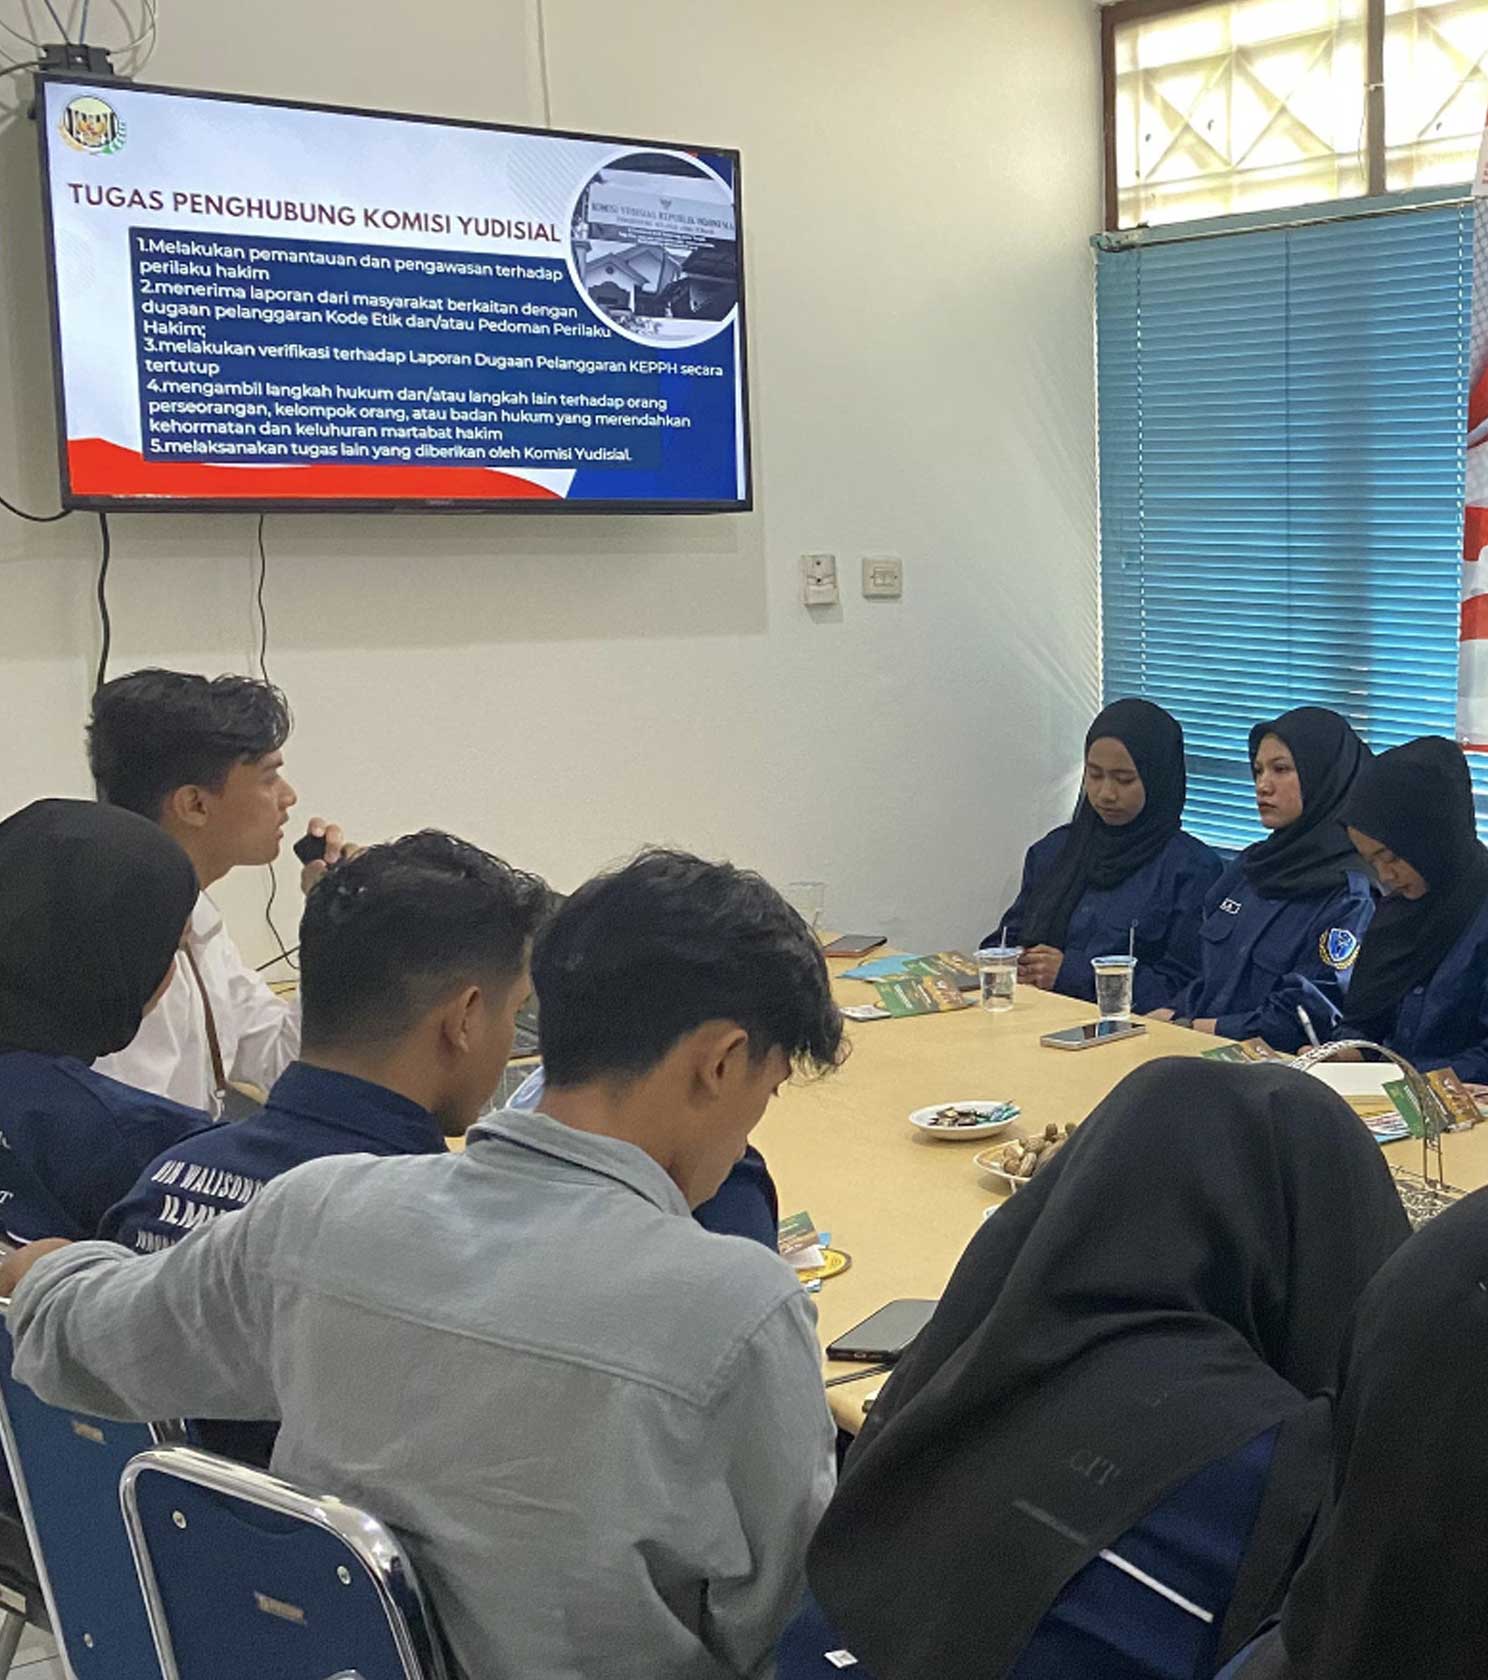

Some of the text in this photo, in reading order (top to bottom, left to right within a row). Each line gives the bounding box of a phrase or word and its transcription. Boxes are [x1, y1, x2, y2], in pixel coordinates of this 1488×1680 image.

[68, 183, 561, 242] TUGAS PENGHUBUNG KOMISI YUDISIAL
[136, 237, 563, 282] 1.Melakukan pemantauan dan pengawasan terhadap
[140, 260, 269, 280] perilaku hakim
[140, 279, 577, 320] 2.menerima laporan dari masyarakat berkaitan dengan
[142, 300, 611, 338] dugaan pelanggaran Kode Etik dan/atau Pedoman Perilaku
[144, 320, 206, 338] Hakim;
[144, 338, 723, 376] 3.melakukan verifikasi terhadap Laporan Dugaan Pelanggaran KEPPH secara
[145, 360, 220, 377] tertutup
[147, 378, 667, 412] 4.mengambil langkah hukum dan/atau langkah lain terhadap orang
[149, 401, 691, 427] perseorangan, kelompok orang, atau badan hukum yang merendahkan
[149, 419, 503, 441] kehormatan dan keluhuran martabat hakim
[151, 438, 288, 456] 5.melaksanakan
[291, 442, 338, 458] tugas
[341, 443, 369, 456] lain
[372, 446, 411, 459] yang
[414, 444, 486, 458] diberikan
[488, 447, 520, 460] oleh
[524, 447, 572, 461] Komisi
